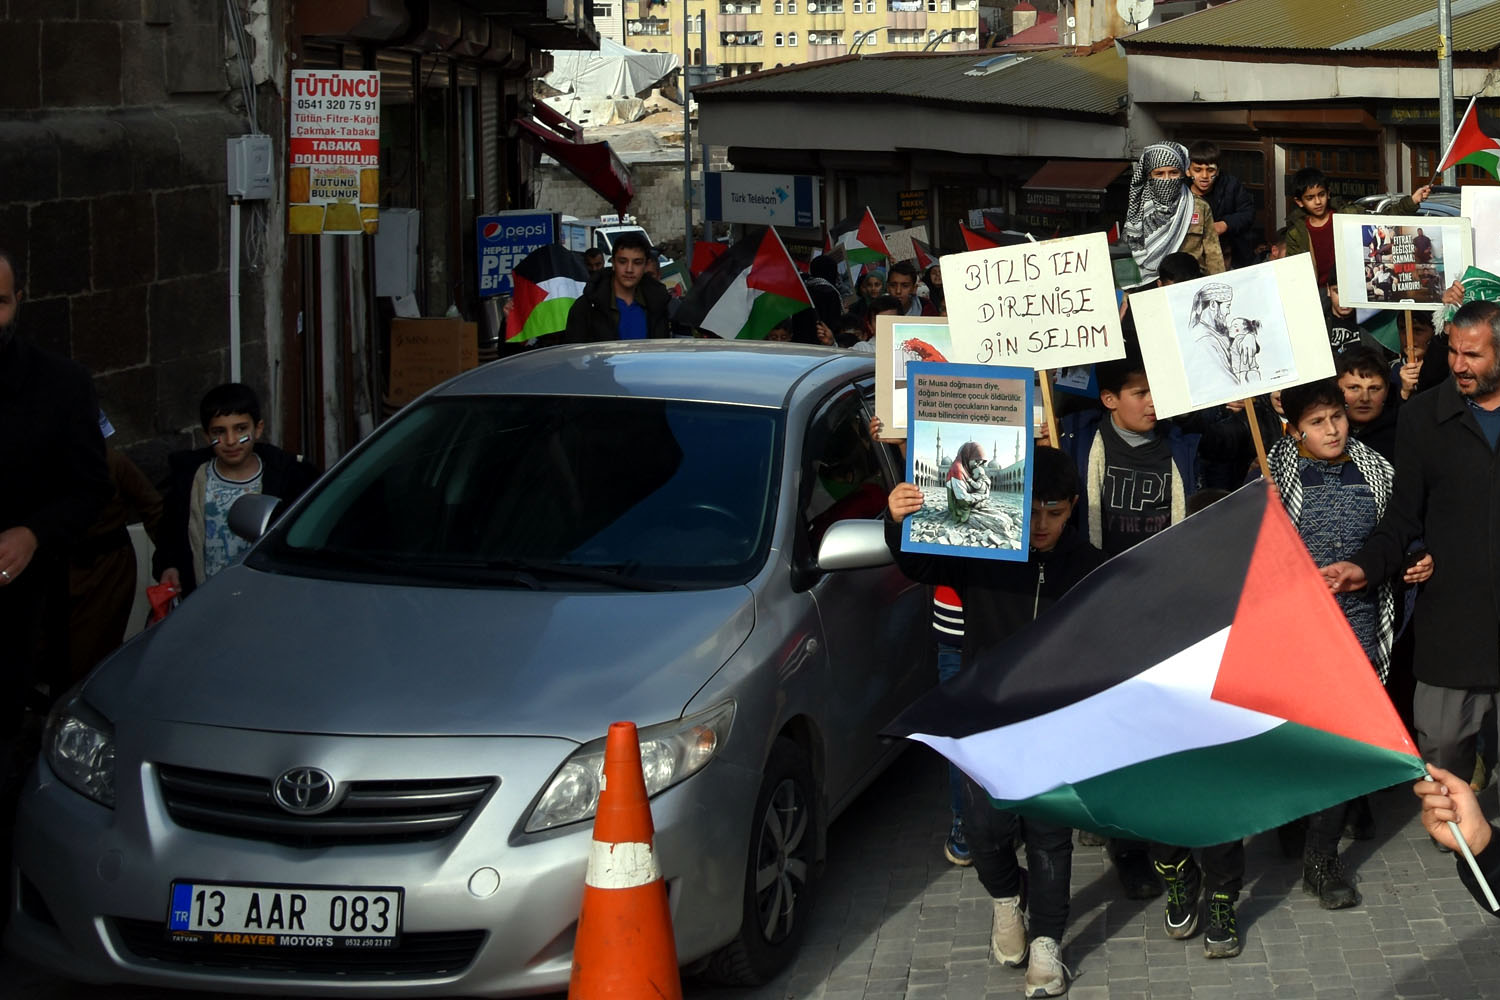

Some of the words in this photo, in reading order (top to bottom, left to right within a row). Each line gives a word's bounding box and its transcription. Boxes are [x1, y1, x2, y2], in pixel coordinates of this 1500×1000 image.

[294, 73, 379, 98] TÜTÜNCÜ
[298, 99, 322, 110] 0541
[326, 100, 346, 110] 320
[349, 101, 361, 110] 75
[364, 101, 376, 110] 91
[295, 113, 379, 126] Tütün-Fitre-Kağıt
[296, 126, 376, 137] Çakmak-Tabaka
[312, 140, 361, 151] TABAKA
[294, 153, 378, 165] DOLDURULUR
[314, 177, 354, 187] TÜTÜNÜ
[311, 189, 358, 199] BULUNUR
[731, 193, 746, 203] Türk
[748, 193, 776, 205] Telekom
[505, 223, 547, 239] pepsi
[1048, 249, 1088, 276] TEN
[977, 286, 1094, 323] DİRENİŞE
[977, 332, 1018, 363] BİN
[1027, 325, 1108, 353] SELAM
[949, 381, 982, 390] doğmasın
[984, 382, 1000, 391] diye,
[918, 389, 939, 398] doğan
[941, 390, 966, 398] binlerce
[968, 392, 989, 400] çocuk
[954, 402, 989, 411] çocukların
[990, 404, 1018, 412] kanında
[918, 410, 936, 418] Musa
[938, 411, 968, 419] bilincinin
[970, 413, 990, 422] çiçeği
[1119, 515, 1141, 533] THE
[175, 911, 188, 922] TR
[195, 890, 225, 927] 13
[244, 893, 306, 930] AAR
[329, 896, 390, 933] 083
[213, 933, 275, 945] KARAYER
[280, 936, 334, 947] MOTOR'S
[345, 938, 360, 947] 0532
